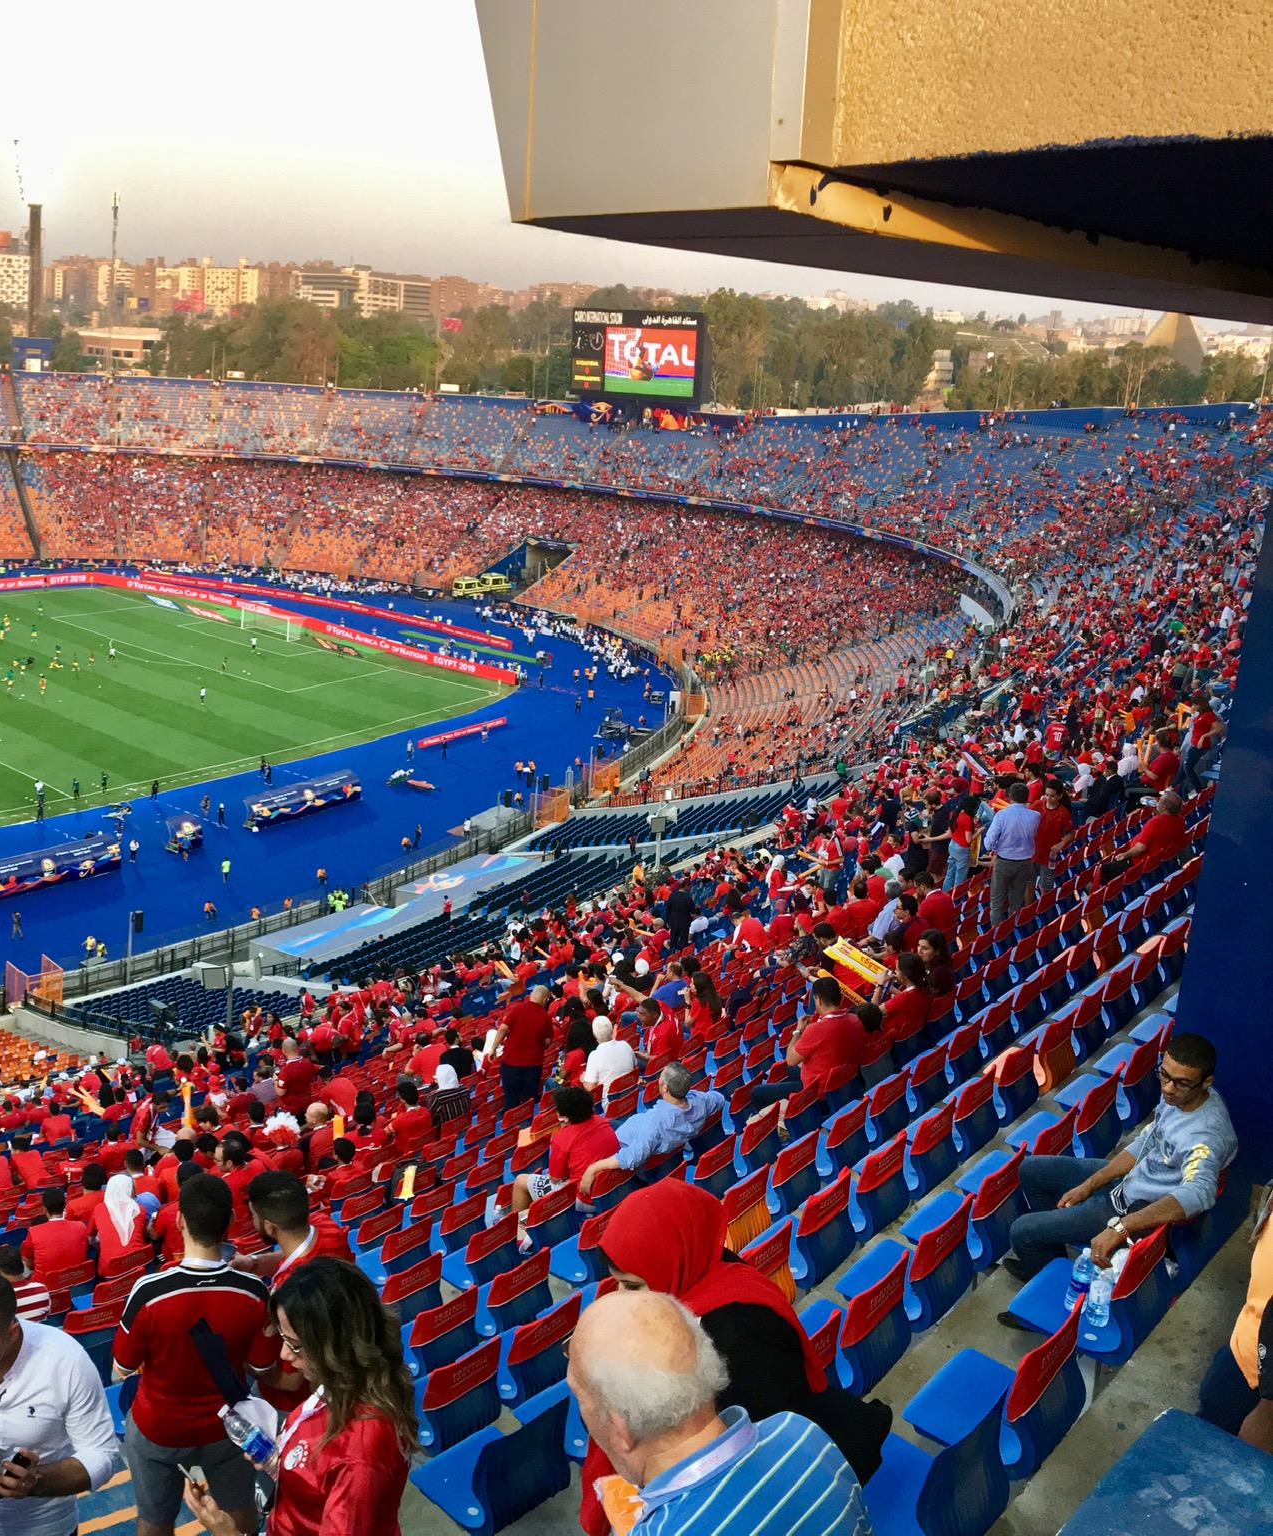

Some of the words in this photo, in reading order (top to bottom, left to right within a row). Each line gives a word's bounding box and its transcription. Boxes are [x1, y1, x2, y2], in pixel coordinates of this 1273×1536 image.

[608, 334, 694, 366] TOTAL
[134, 582, 158, 593] TOTAL
[158, 586, 184, 597] AFRICA
[184, 589, 198, 598] CUP
[331, 625, 355, 640] TOTAL
[355, 633, 379, 649] AFRICA
[391, 645, 401, 654] OF
[400, 646, 428, 661] NATIONS
[433, 655, 457, 669] EGYPT
[458, 660, 476, 673] 2019
